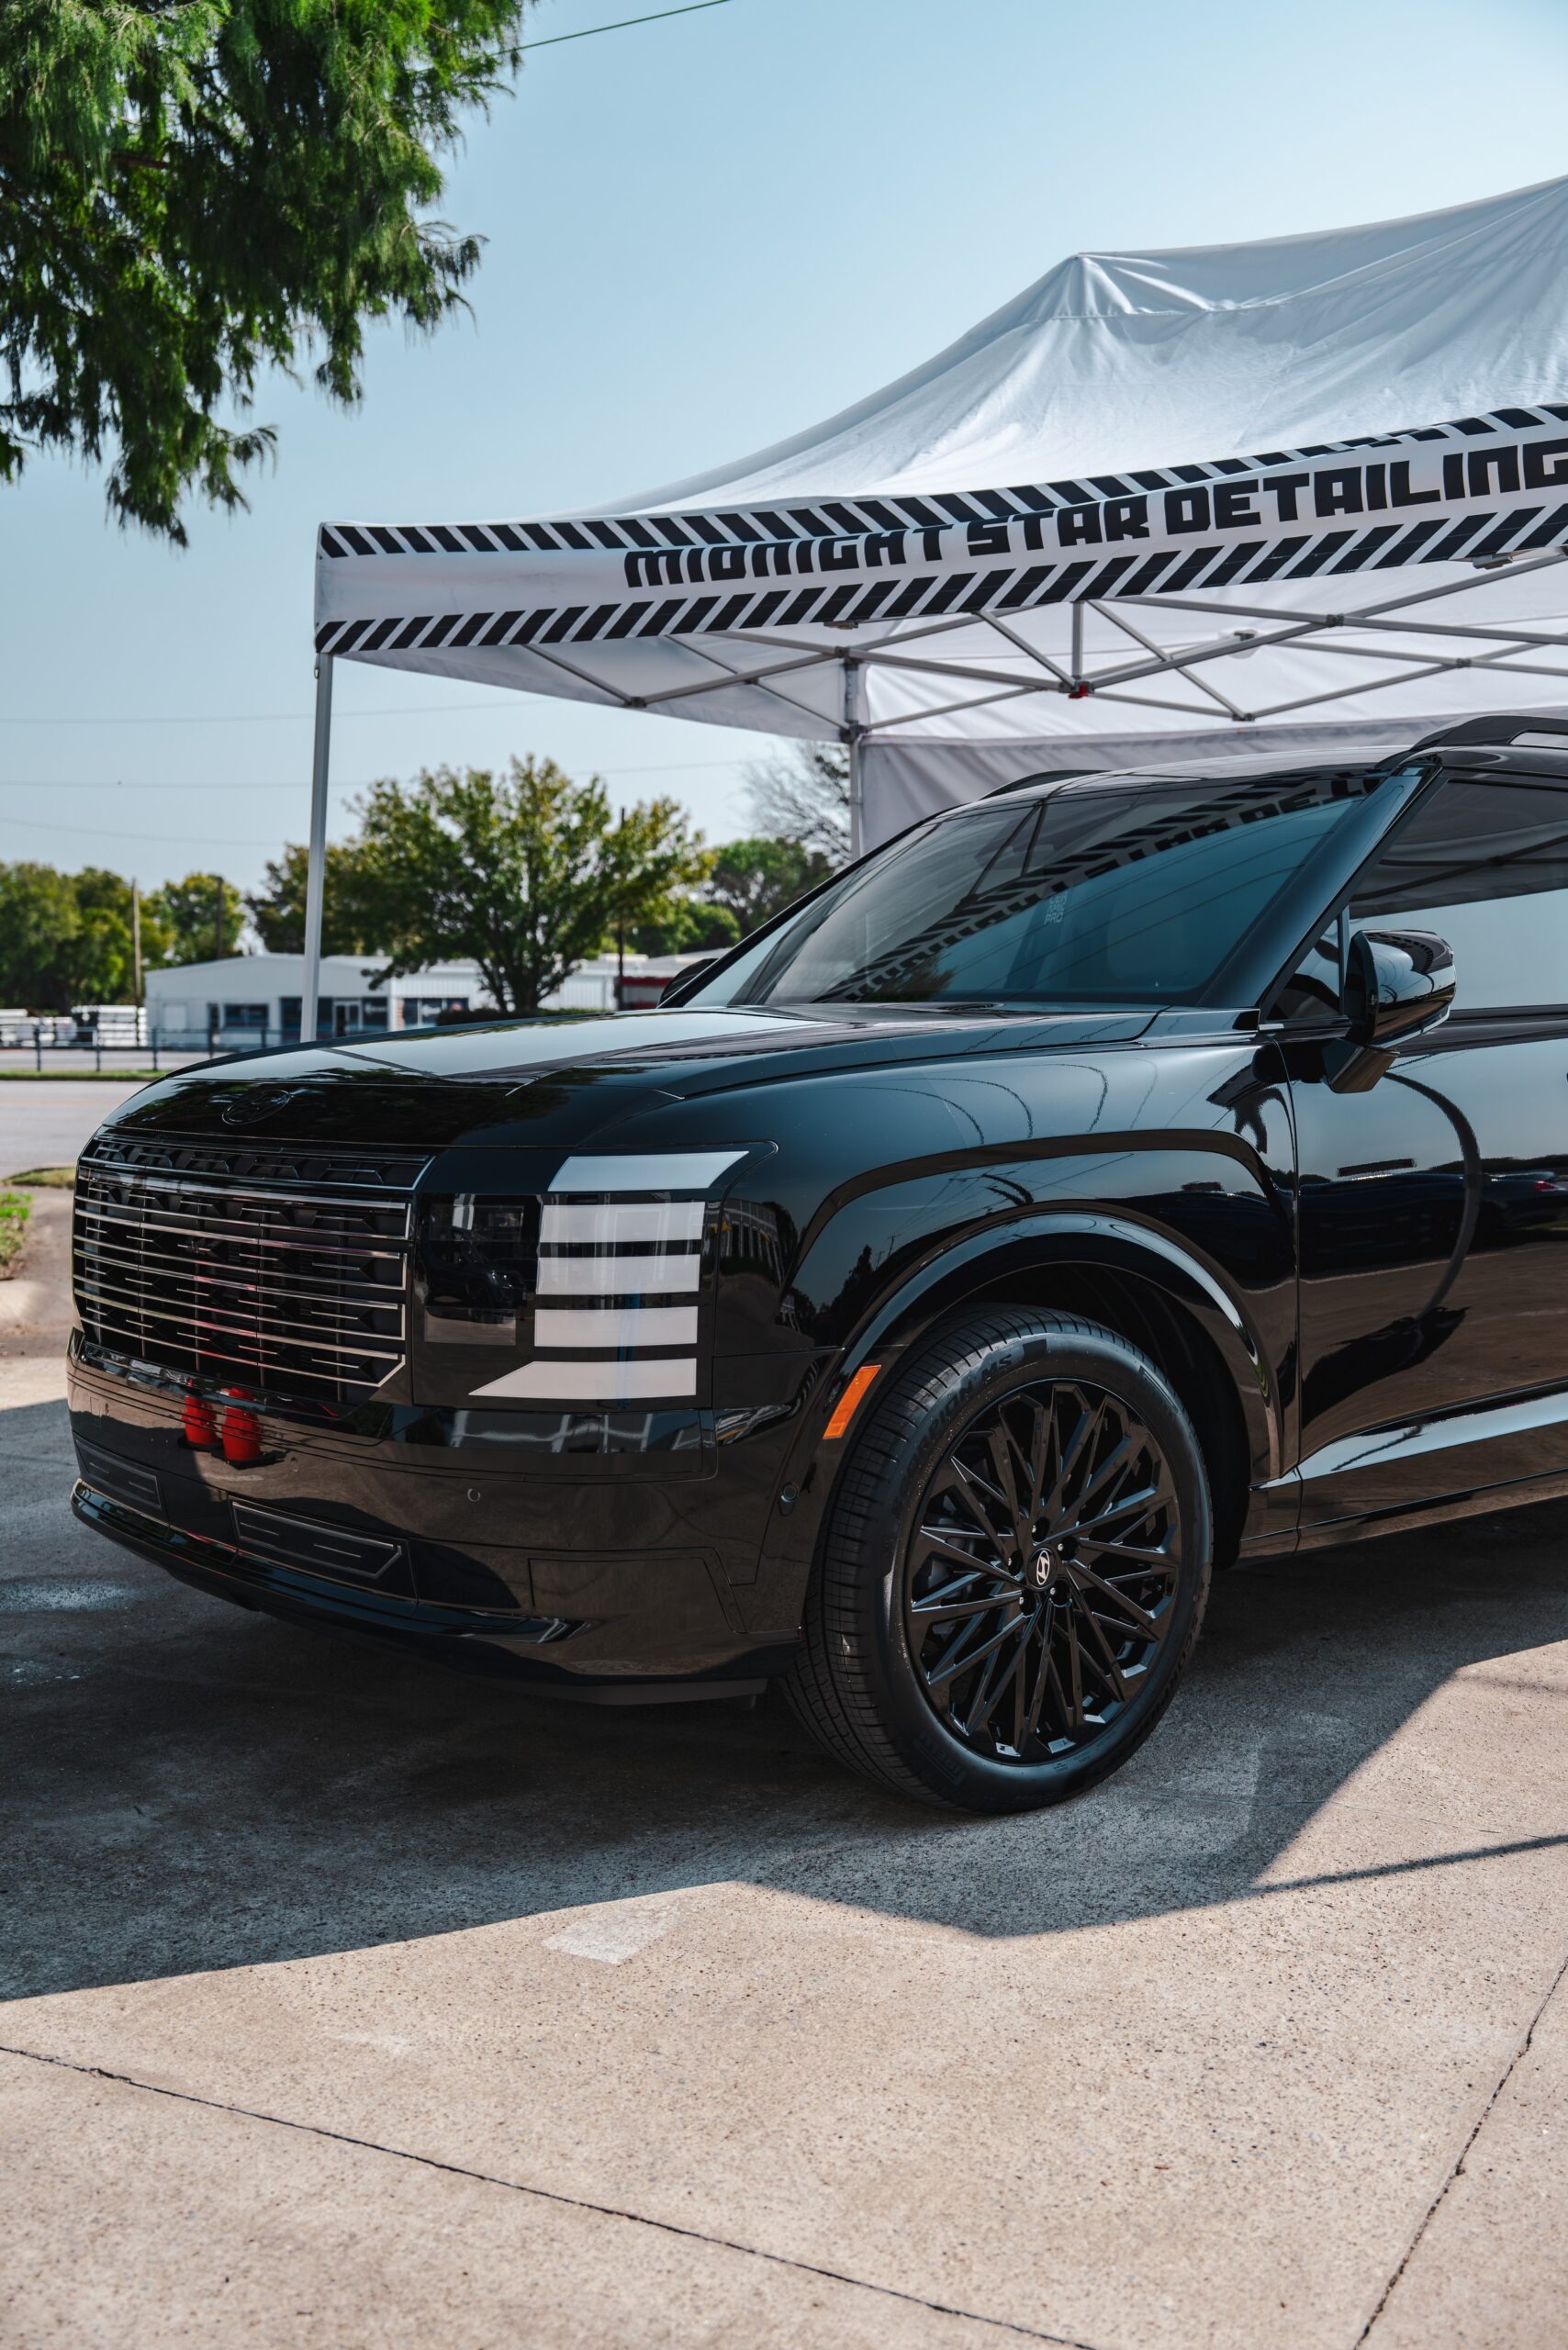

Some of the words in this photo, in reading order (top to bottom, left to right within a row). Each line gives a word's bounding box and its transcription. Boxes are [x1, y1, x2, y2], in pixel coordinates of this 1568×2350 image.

[623, 523, 953, 588] MIDNIGHT
[966, 494, 1151, 557] STAR
[1163, 436, 1568, 536] DETAILING
